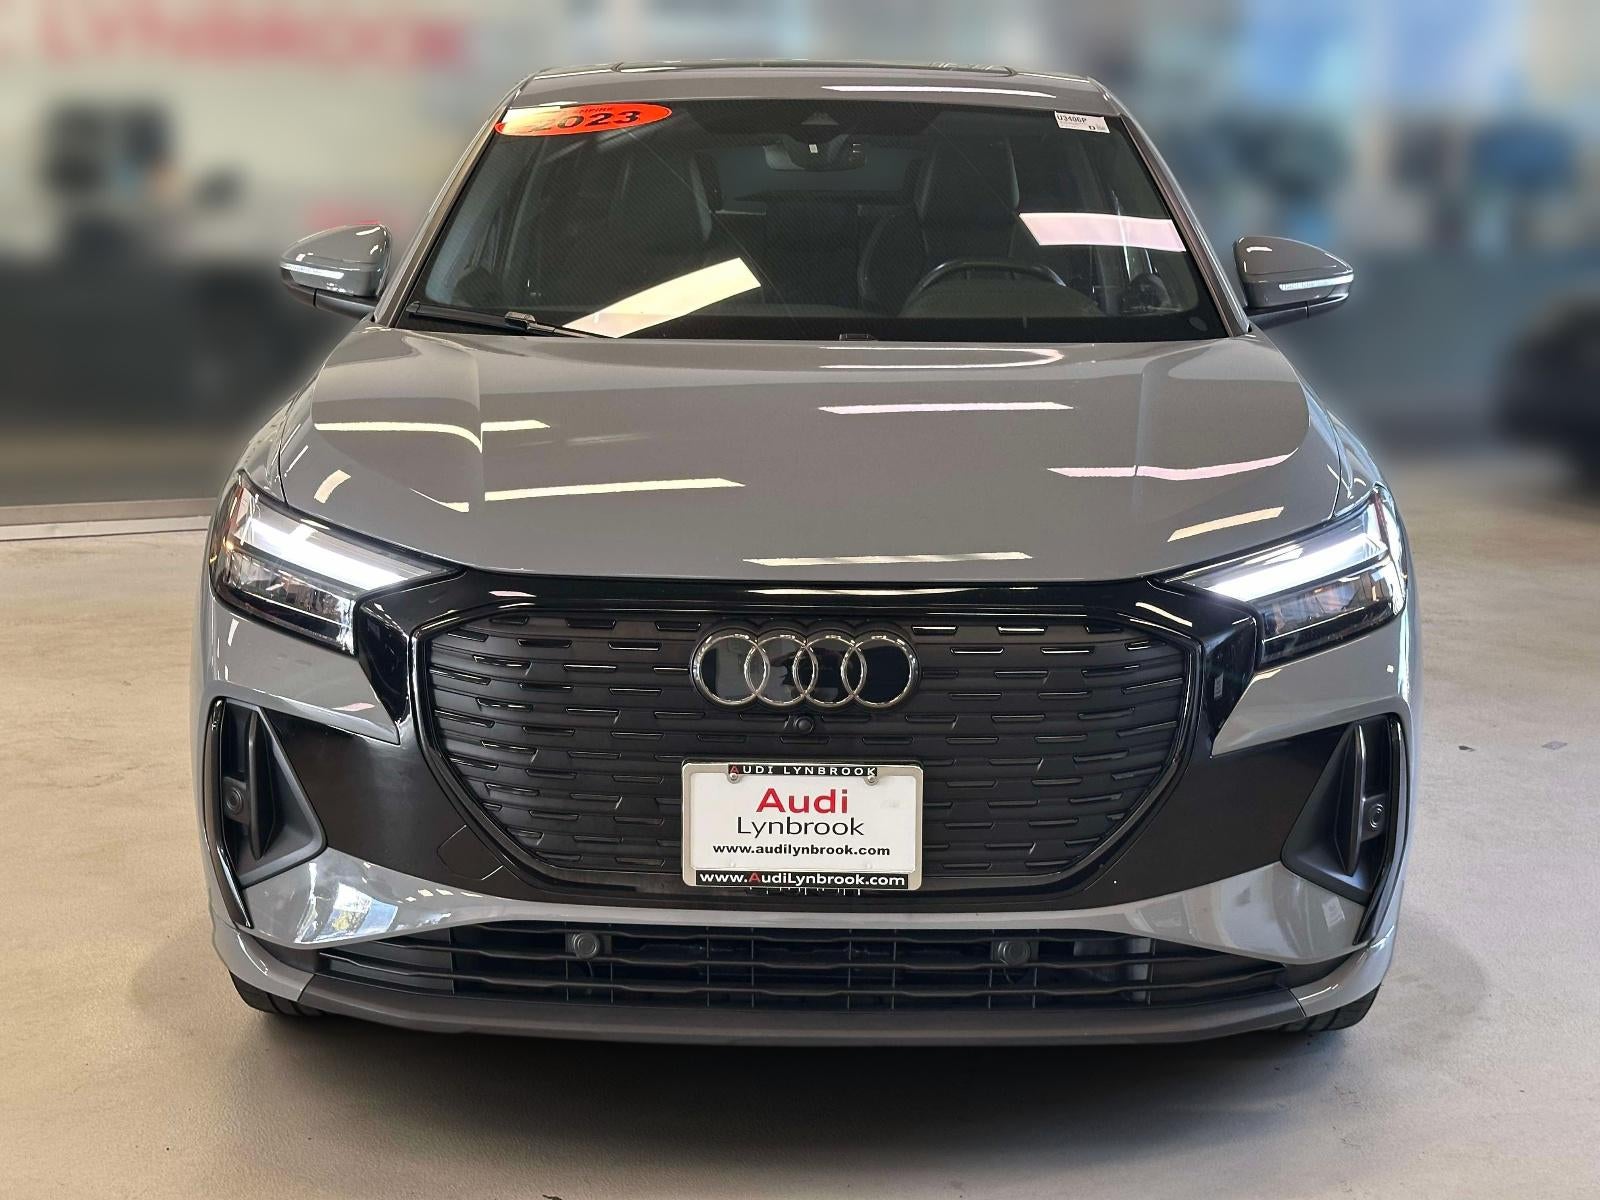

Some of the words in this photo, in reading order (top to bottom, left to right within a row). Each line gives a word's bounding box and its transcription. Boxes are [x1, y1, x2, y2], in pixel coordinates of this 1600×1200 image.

[730, 764, 774, 775] AUDI
[783, 766, 876, 777] LYNBROOK
[756, 787, 848, 814] Audi
[737, 816, 864, 838] Lynbrook
[712, 844, 890, 856] www.audilynbrook.com
[699, 872, 905, 887] www.AudiLynbrook.com
